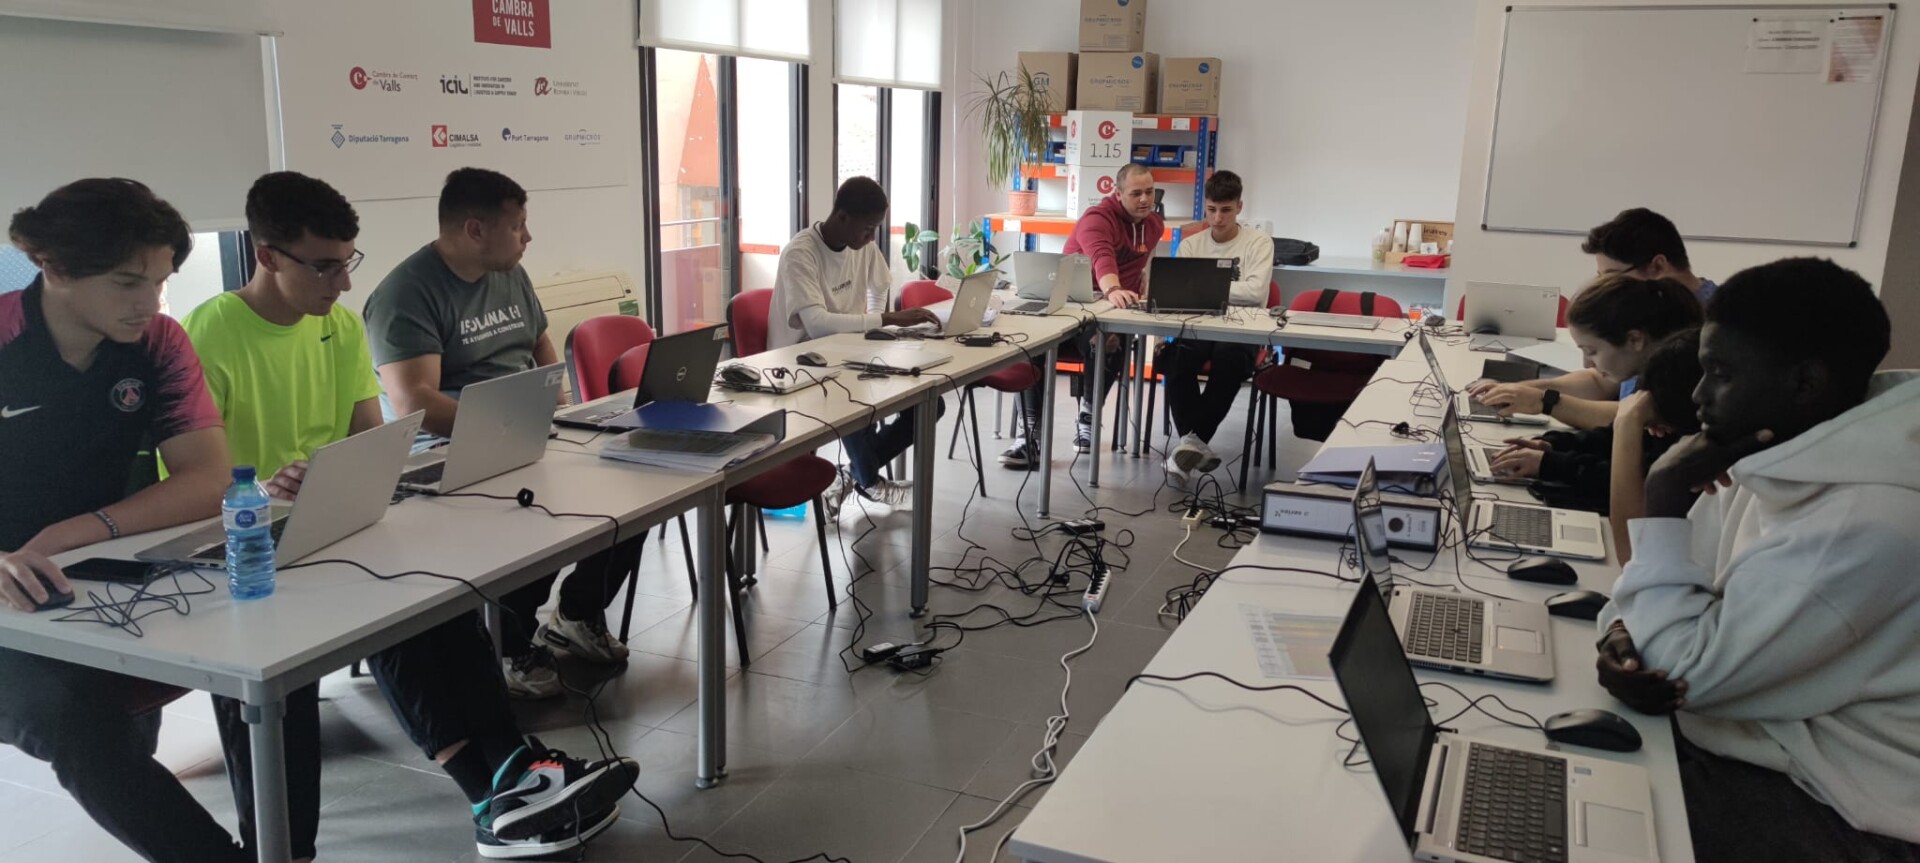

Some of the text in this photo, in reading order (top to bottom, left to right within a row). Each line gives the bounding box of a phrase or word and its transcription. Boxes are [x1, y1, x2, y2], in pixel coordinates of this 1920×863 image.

[492, 0, 534, 17] CAMBRA
[493, 16, 535, 37] DE VALLS
[379, 79, 401, 92] Valls
[380, 135, 409, 144] Tarragona
[449, 134, 479, 142] CIMALSA
[1090, 143, 1121, 159] 1.15
